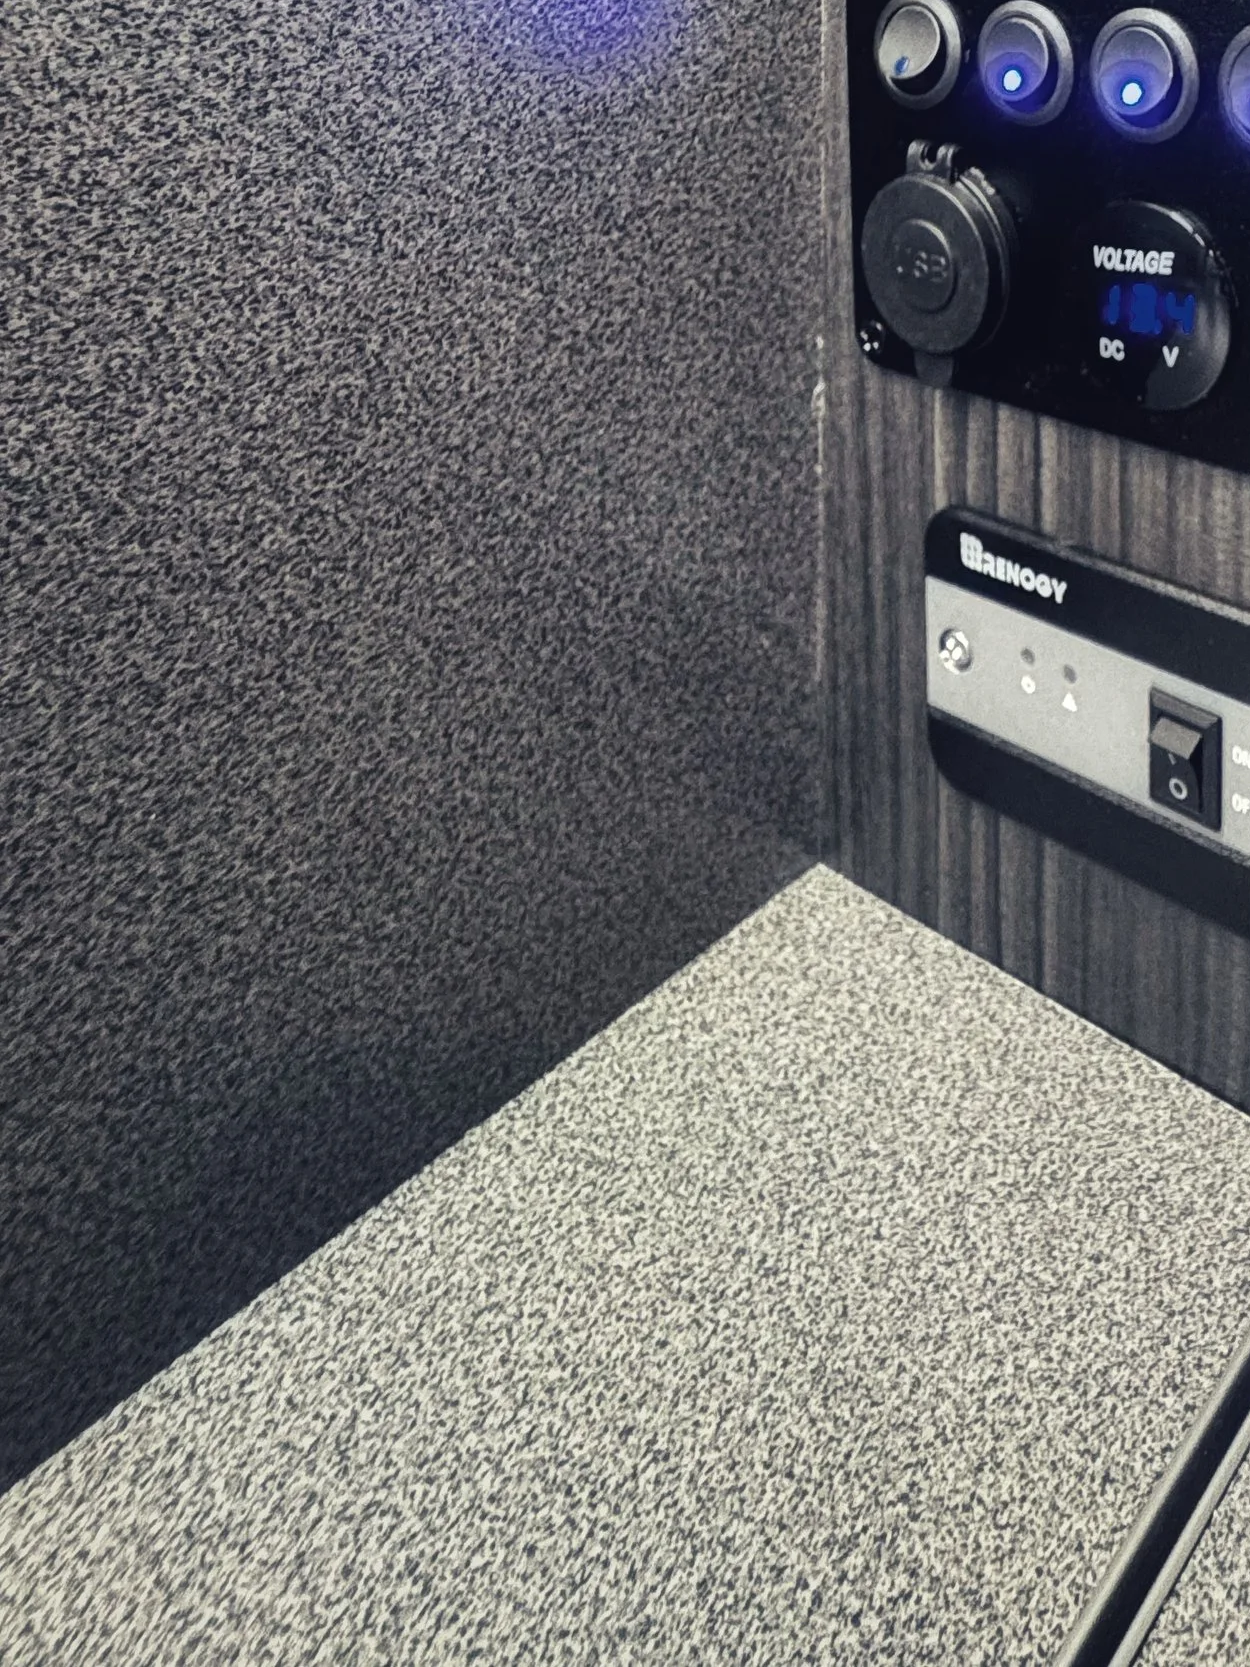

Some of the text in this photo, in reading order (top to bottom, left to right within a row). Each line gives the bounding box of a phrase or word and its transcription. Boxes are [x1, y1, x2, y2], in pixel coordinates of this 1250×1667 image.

[1093, 244, 1175, 276] VOLTAGE
[1099, 336, 1125, 362] DC
[1162, 345, 1180, 368] V
